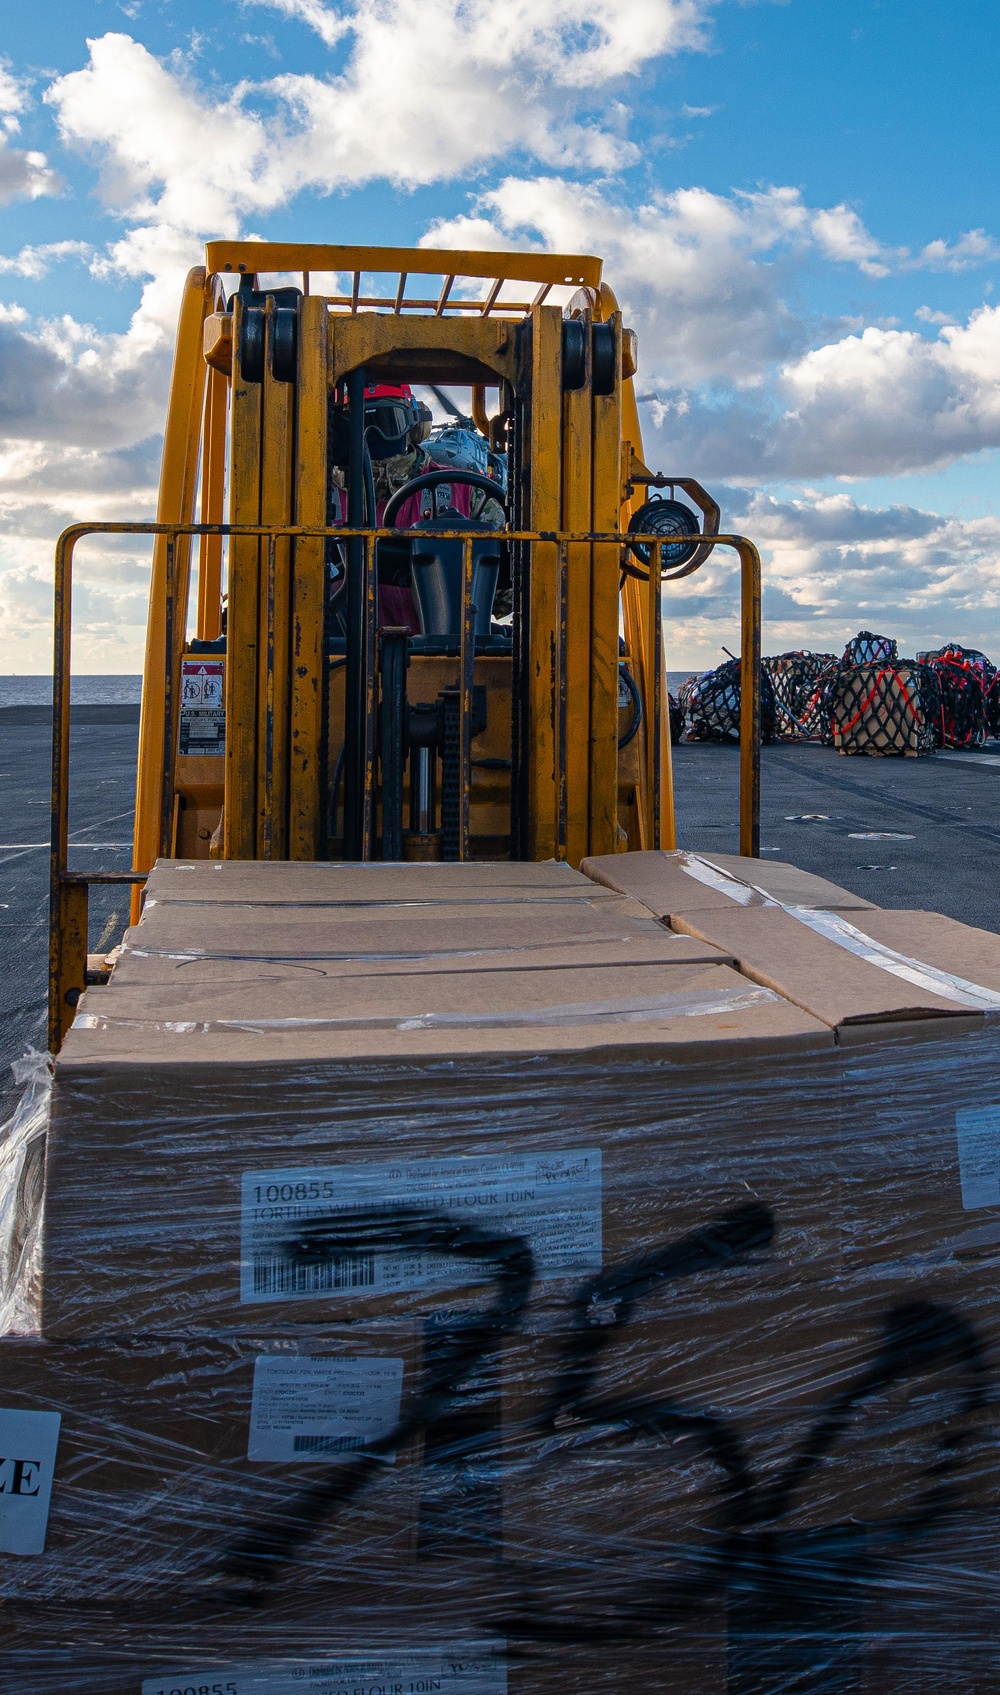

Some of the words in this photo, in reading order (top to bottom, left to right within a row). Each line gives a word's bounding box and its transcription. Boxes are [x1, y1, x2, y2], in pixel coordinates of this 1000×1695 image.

[253, 1182, 334, 1204] 100855
[252, 1204, 325, 1221] TORTILLA
[383, 1196, 443, 1209] PRESSED
[449, 1193, 498, 1208] FLOUR
[505, 1190, 535, 1203] 10IN
[408, 1679, 441, 1693] 10IN
